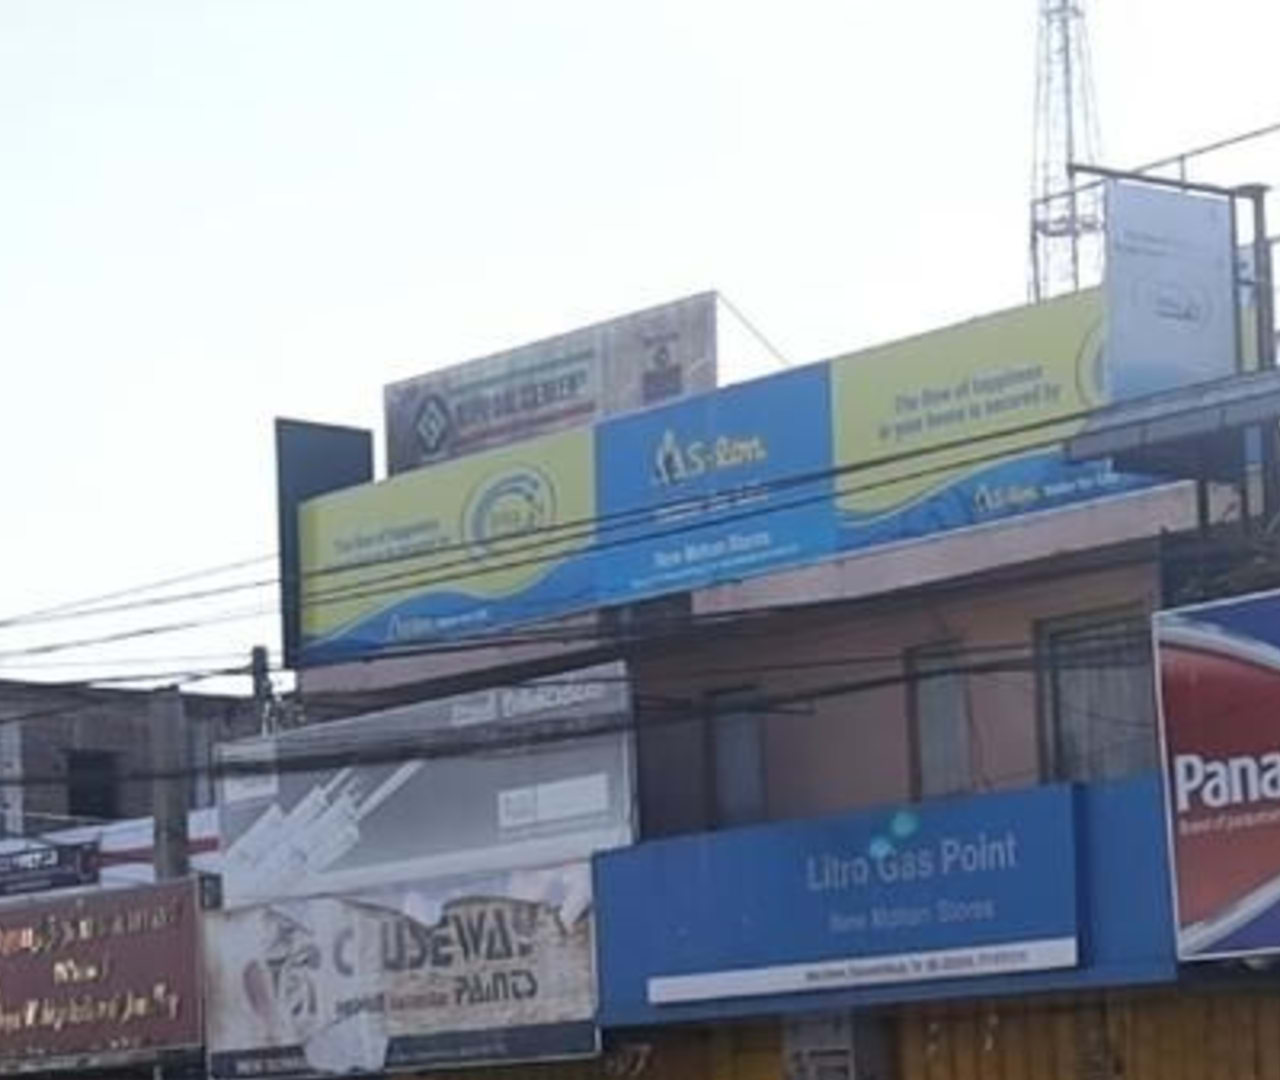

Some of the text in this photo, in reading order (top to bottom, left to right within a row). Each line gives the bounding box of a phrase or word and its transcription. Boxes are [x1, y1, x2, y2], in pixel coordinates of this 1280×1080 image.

[806, 831, 1018, 892] Litro Gas Point
